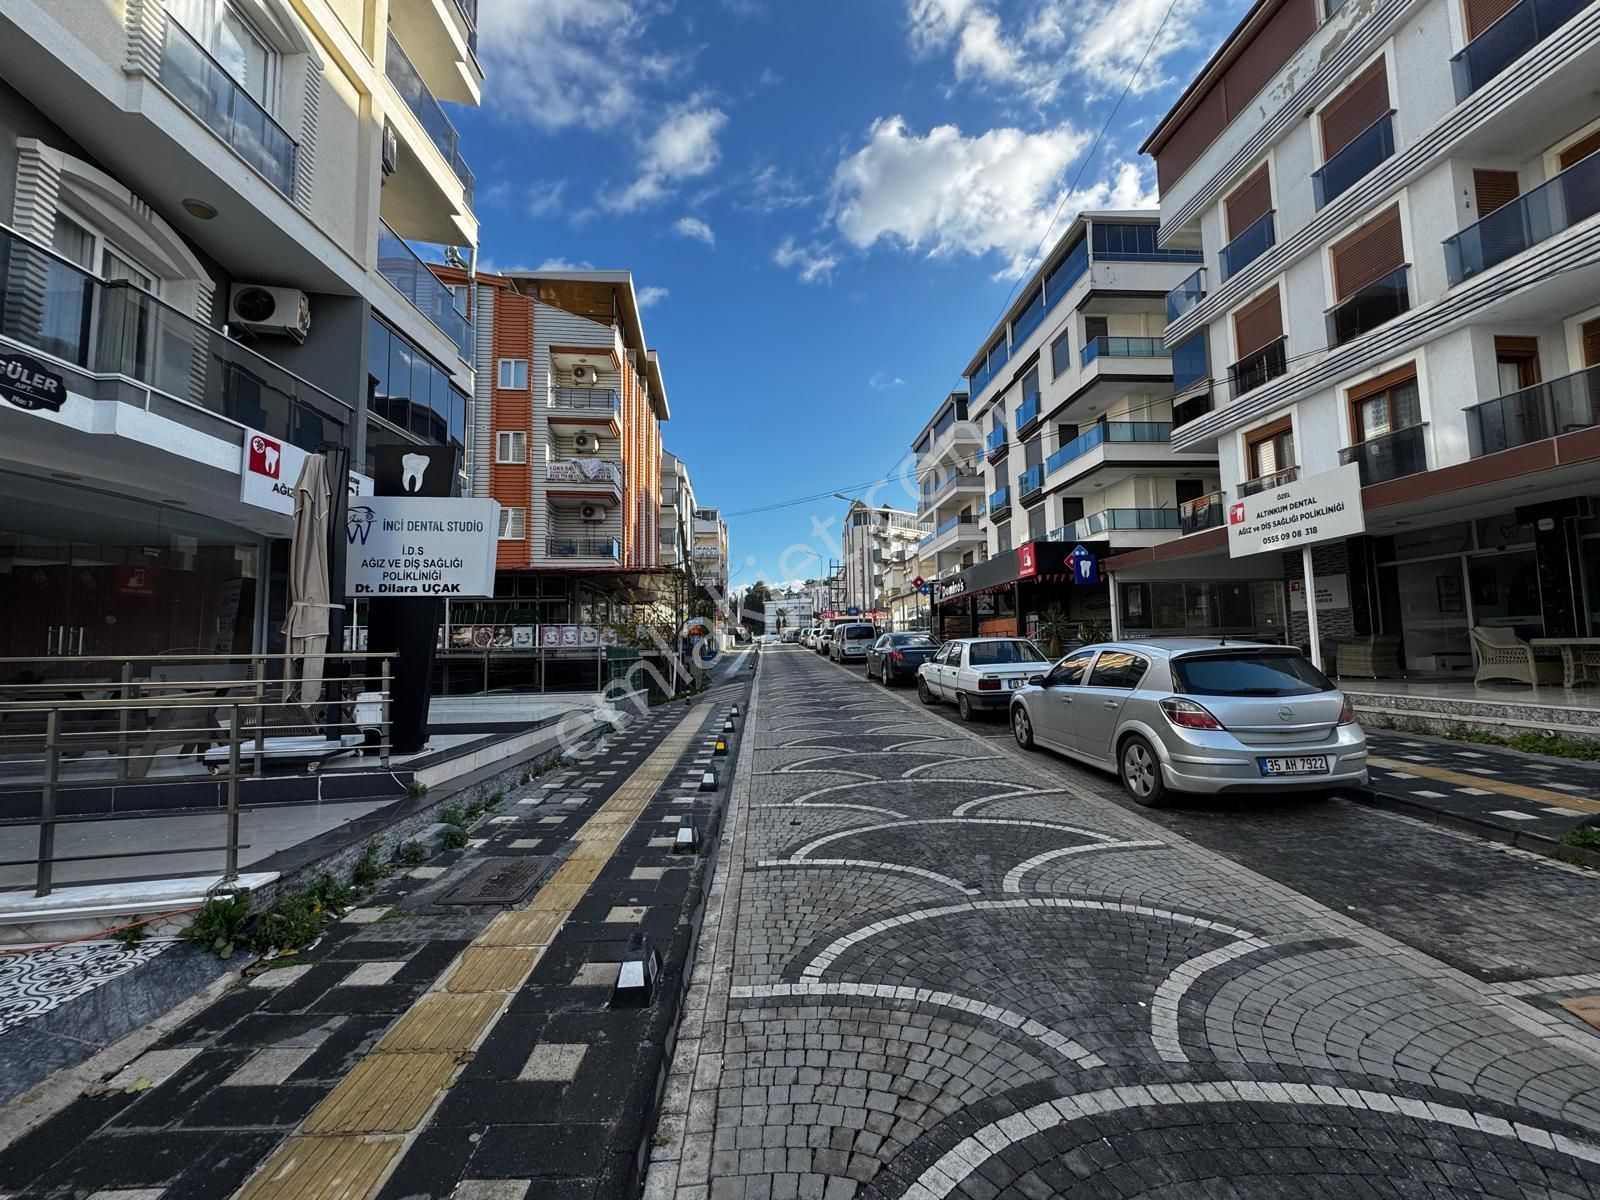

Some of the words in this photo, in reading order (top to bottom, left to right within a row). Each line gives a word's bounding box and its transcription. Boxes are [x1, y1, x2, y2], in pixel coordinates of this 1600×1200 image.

[1277, 492, 1291, 501] ÖZEL
[1256, 504, 1289, 520] ALTINKUM
[1289, 497, 1317, 511] DENTAL
[383, 518, 404, 532] İNCİ
[407, 520, 445, 532] DENTAL
[447, 519, 483, 532] STUDİO
[1238, 527, 1252, 536] AĞIZ
[1261, 522, 1272, 533] DİŞ
[1272, 514, 1299, 528] SAĞLIĞI
[1300, 502, 1345, 521] POLİKLİNİĞİ
[1263, 533, 1280, 545] 0555
[1280, 532, 1290, 541] 09
[1292, 530, 1302, 539] 08
[1305, 526, 1318, 536] 318
[402, 544, 424, 556] İ.D.S
[361, 558, 385, 568] AĞIZ
[388, 559, 401, 568] VE
[404, 558, 420, 570] DİŞ
[423, 558, 463, 568] SAĞLIĞI
[382, 569, 442, 581] POLİKLİNİĞİ
[355, 583, 374, 593] Dt.
[378, 583, 418, 593] Dilara
[422, 583, 461, 594] UÇAK
[942, 578, 964, 598] Domino's
[1267, 759, 1281, 771] 35
[1285, 759, 1297, 770] AH
[1300, 758, 1325, 770] 7922
